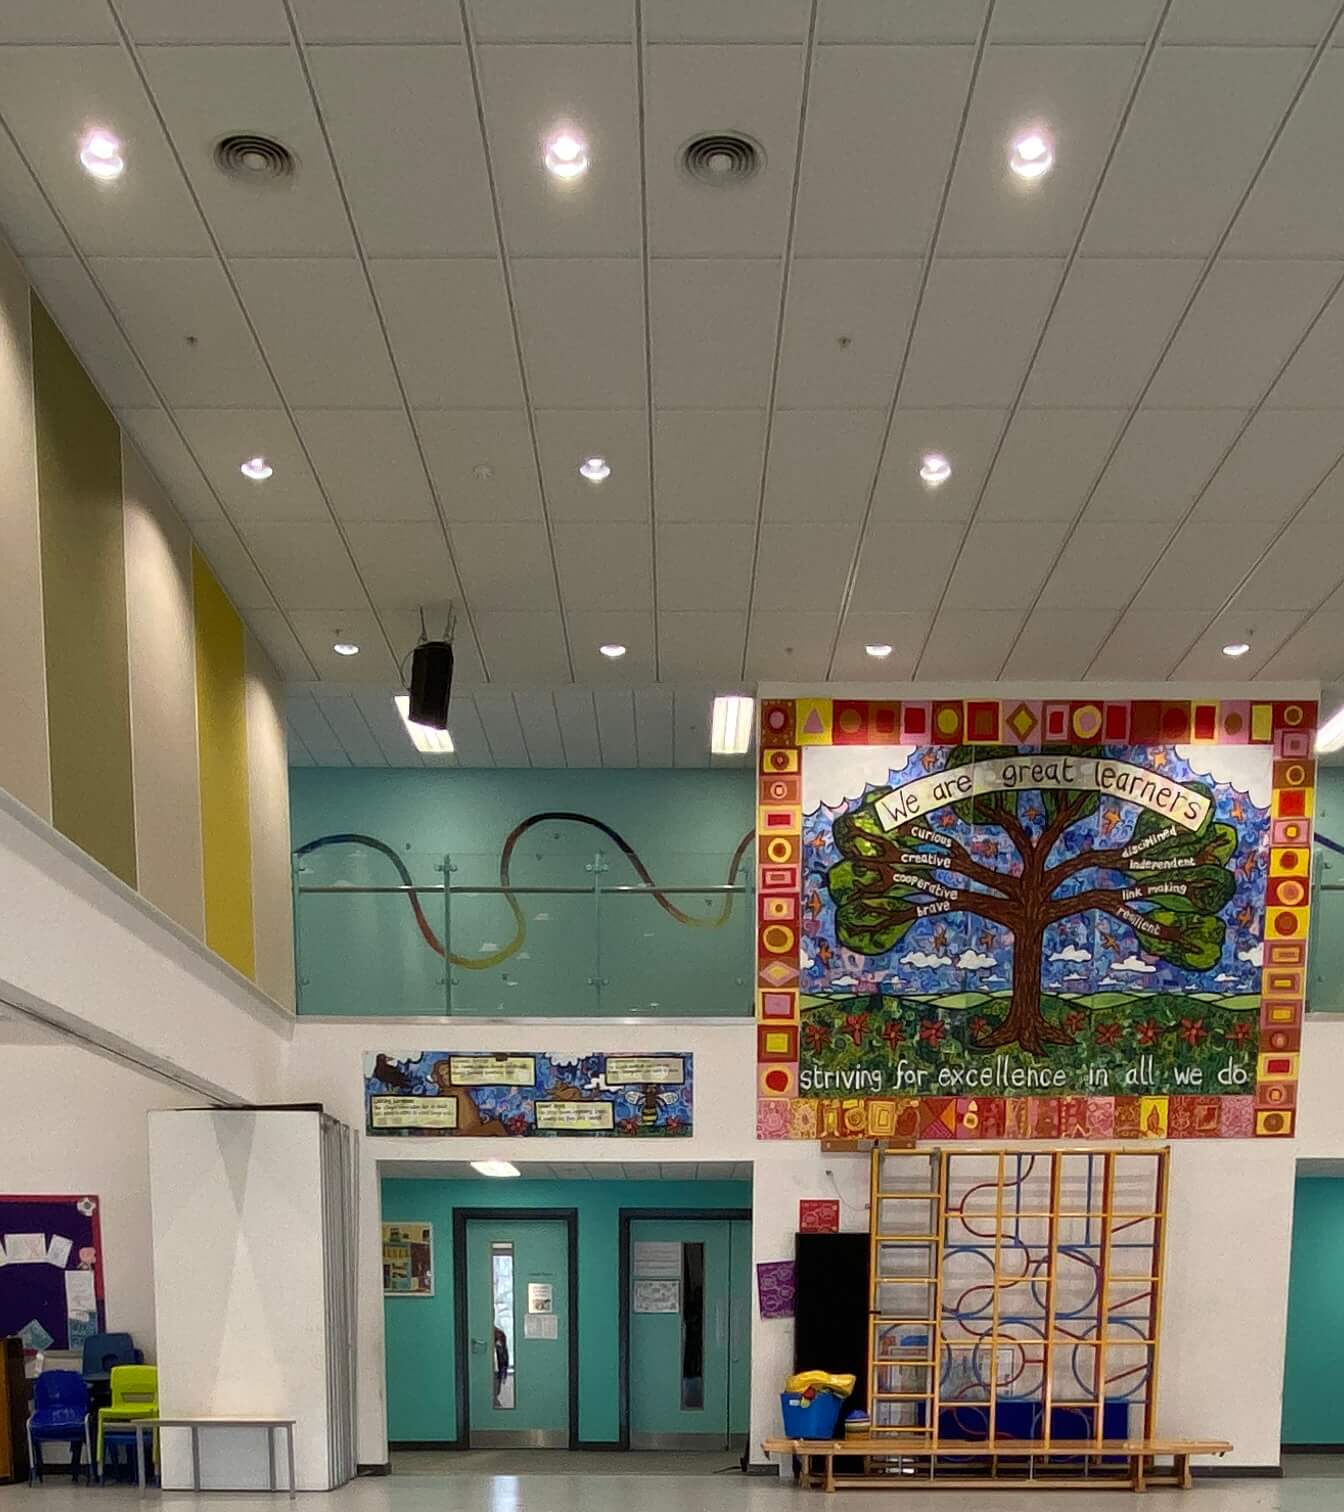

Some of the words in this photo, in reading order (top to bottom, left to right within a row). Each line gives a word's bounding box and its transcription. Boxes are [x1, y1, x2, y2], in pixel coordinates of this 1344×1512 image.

[881, 790, 920, 822] We
[933, 775, 973, 801] are
[1002, 758, 1074, 788] great
[1095, 761, 1202, 820] learners
[911, 826, 952, 848] curious
[1122, 824, 1177, 858] disciplined
[901, 853, 951, 868] creative
[1130, 857, 1196, 870] independent
[893, 873, 958, 900] cooperative
[1122, 887, 1143, 901] link
[1148, 882, 1187, 895] making
[916, 901, 950, 917] brave
[1116, 907, 1161, 935] resilient
[800, 1063, 882, 1092] striving
[893, 1059, 928, 1090] for
[939, 1055, 1066, 1087] excellence
[1088, 1062, 1109, 1086] in
[1125, 1054, 1156, 1086] all
[1174, 1067, 1203, 1086] we
[1217, 1056, 1248, 1086] do
